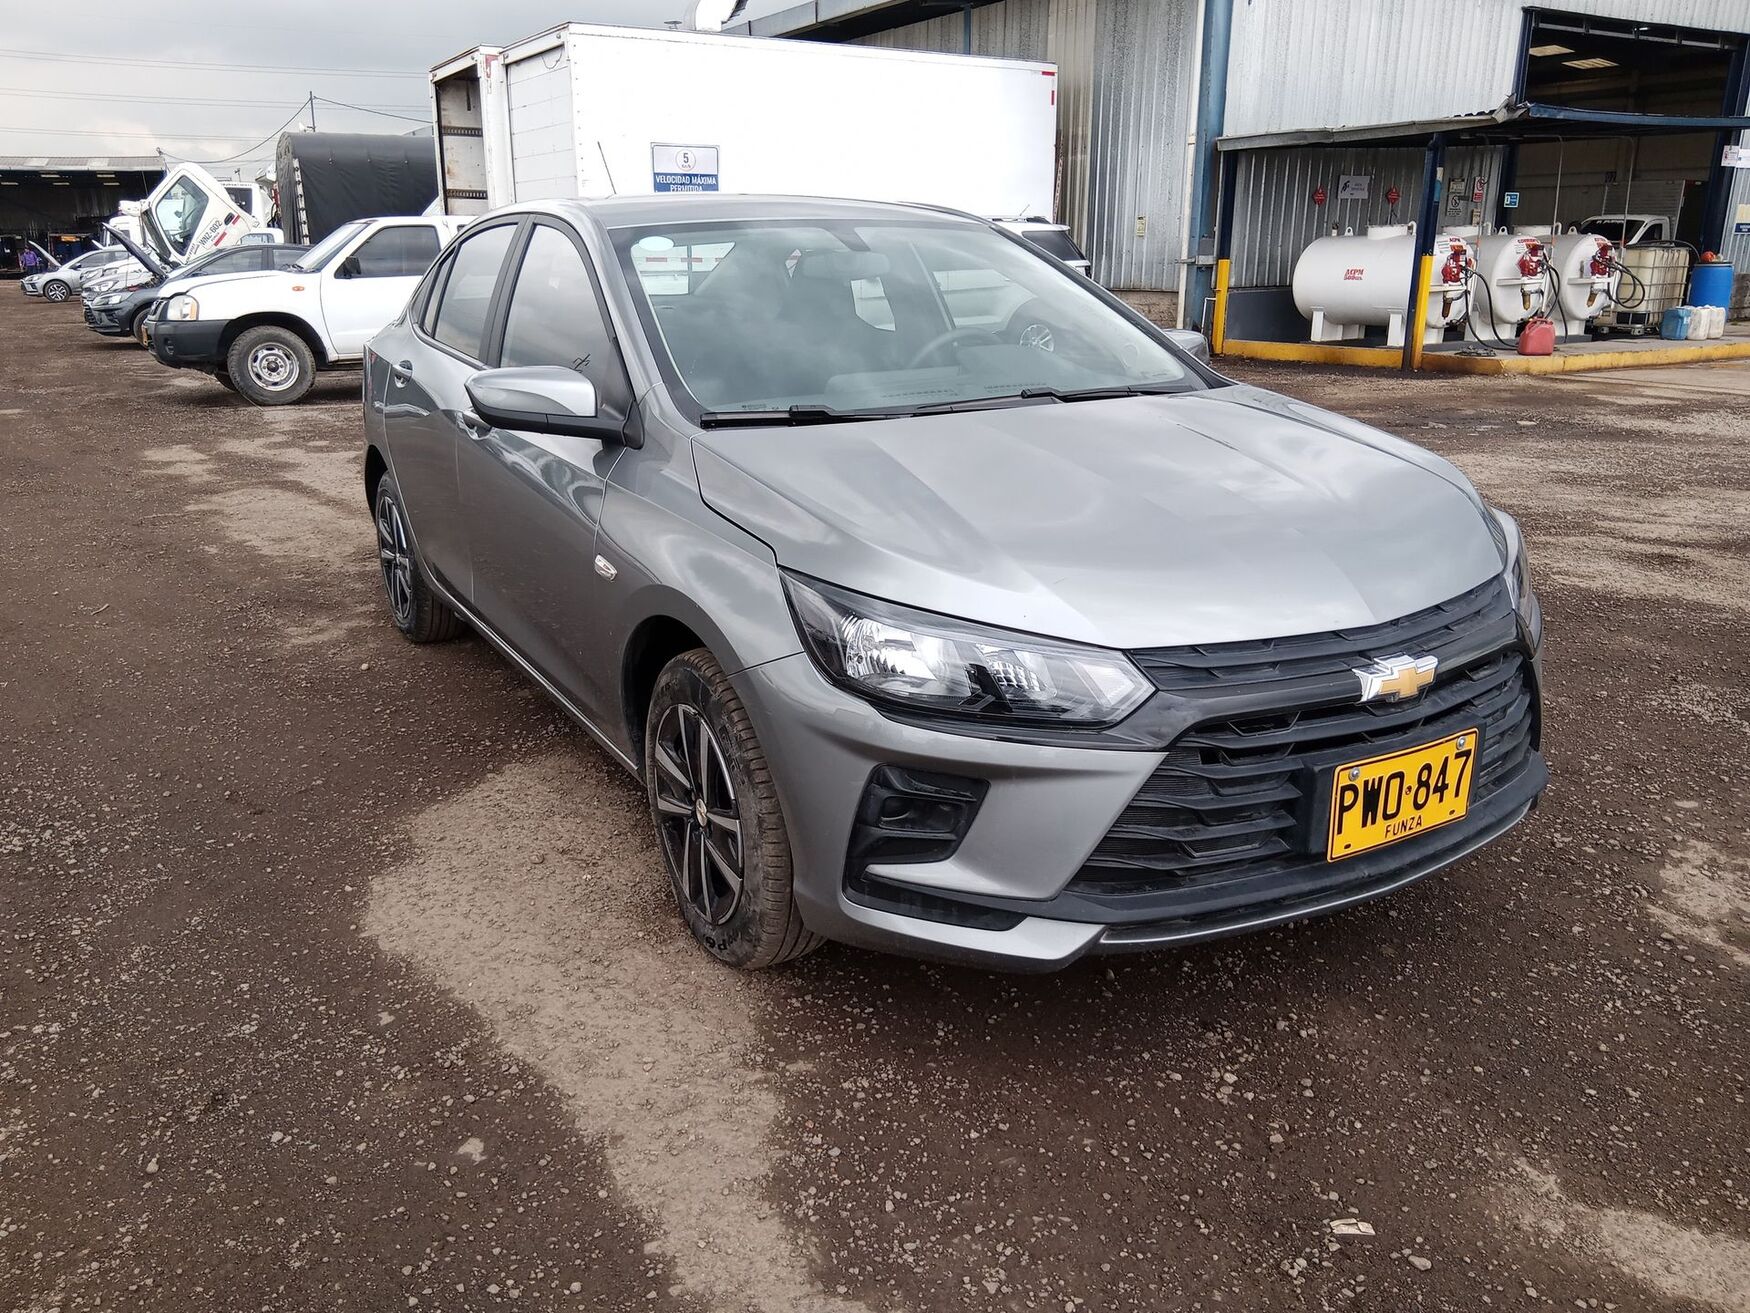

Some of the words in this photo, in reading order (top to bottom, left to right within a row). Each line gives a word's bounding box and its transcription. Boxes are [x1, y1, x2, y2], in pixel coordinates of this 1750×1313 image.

[683, 152, 689, 164] 5
[655, 175, 691, 184] VELOCIDAD
[691, 175, 717, 185] MÁXIMA
[1385, 814, 1422, 839] FUNZA
